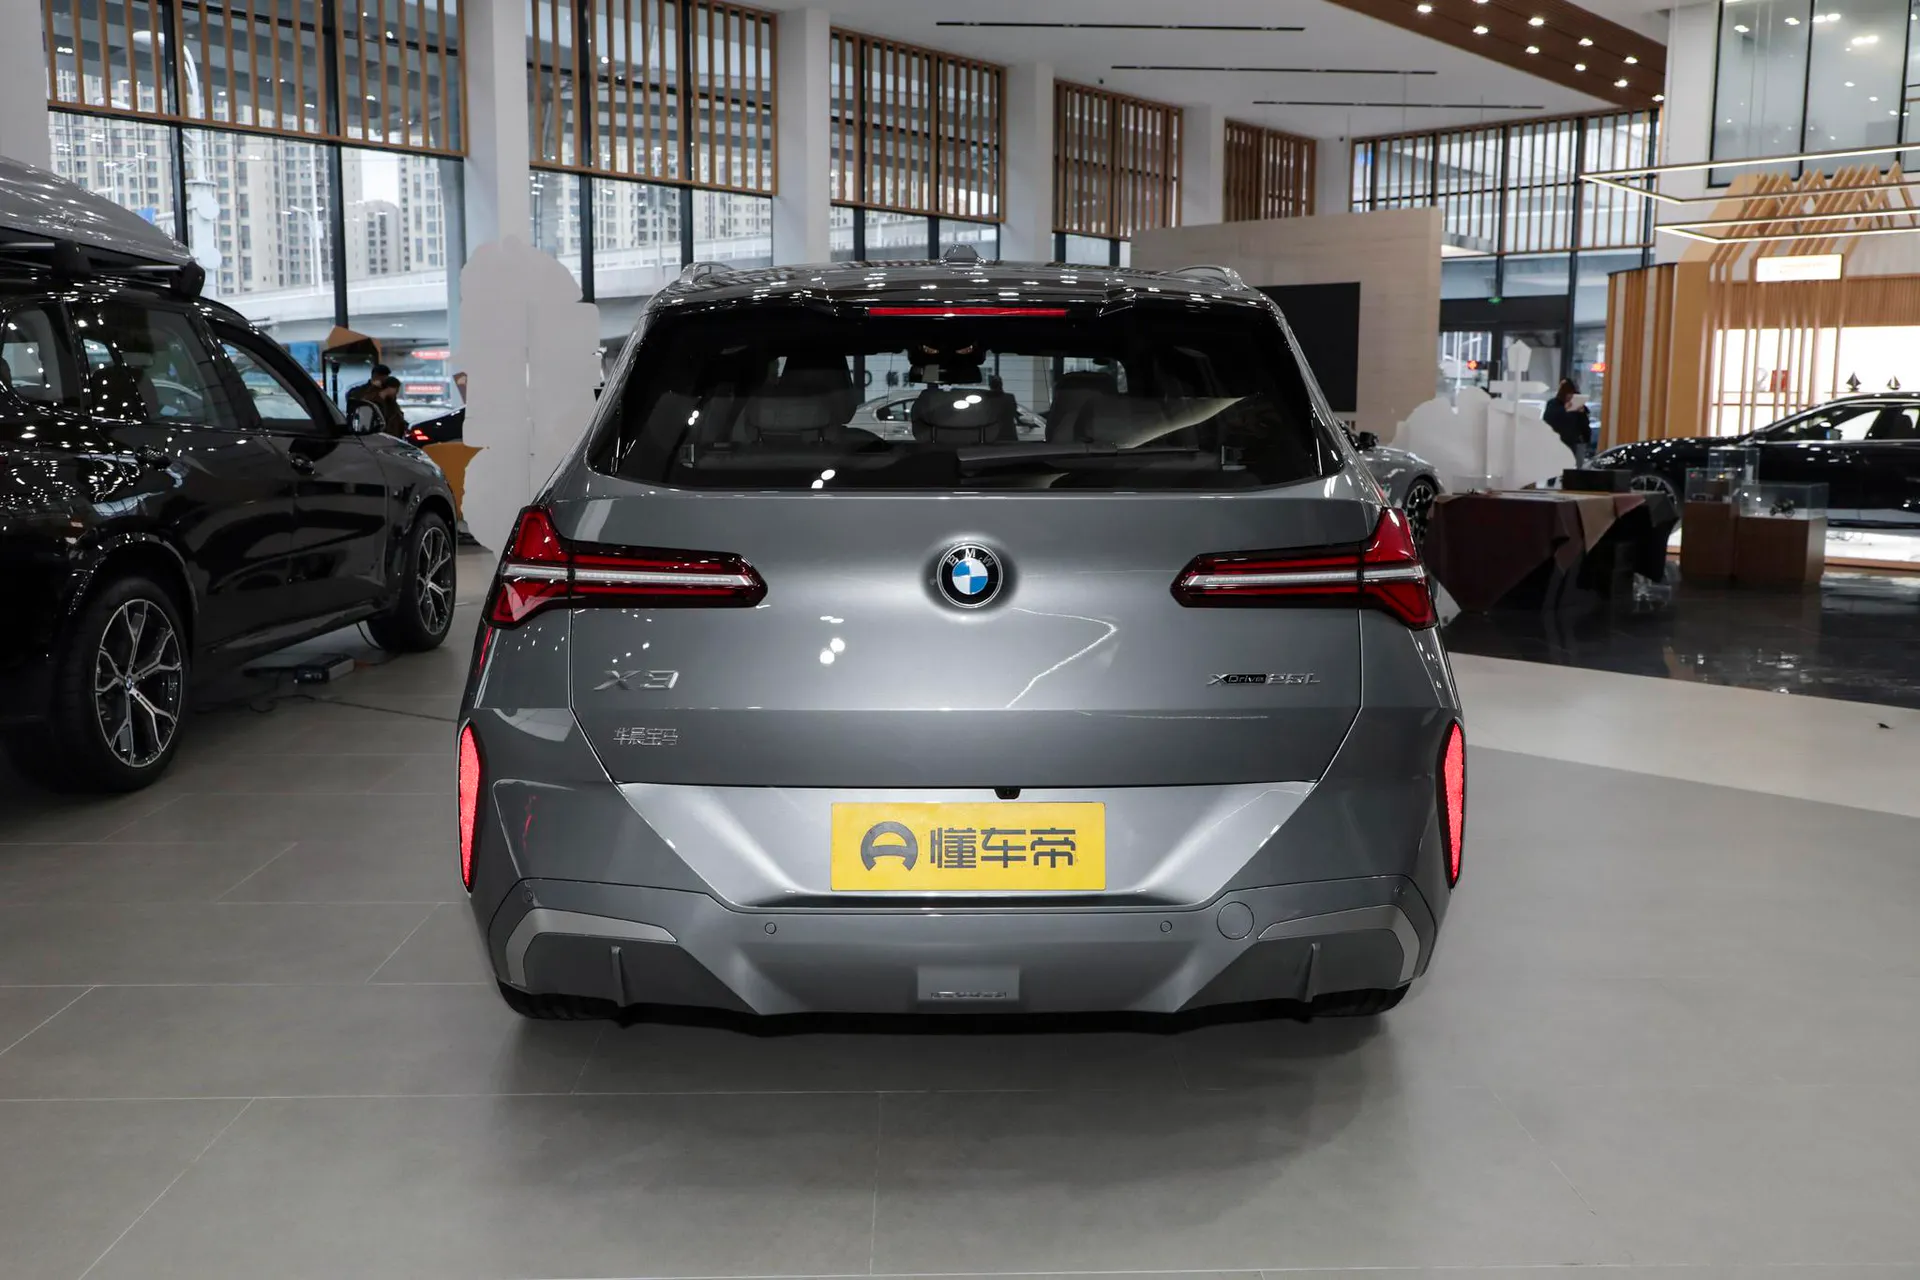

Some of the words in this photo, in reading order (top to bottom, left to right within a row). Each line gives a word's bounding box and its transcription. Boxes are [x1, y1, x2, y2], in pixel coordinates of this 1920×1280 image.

[946, 547, 996, 568] BMW
[592, 669, 679, 691] X3
[612, 726, 679, 746] 华晨宝马
[929, 826, 1077, 869] 懂车帝
